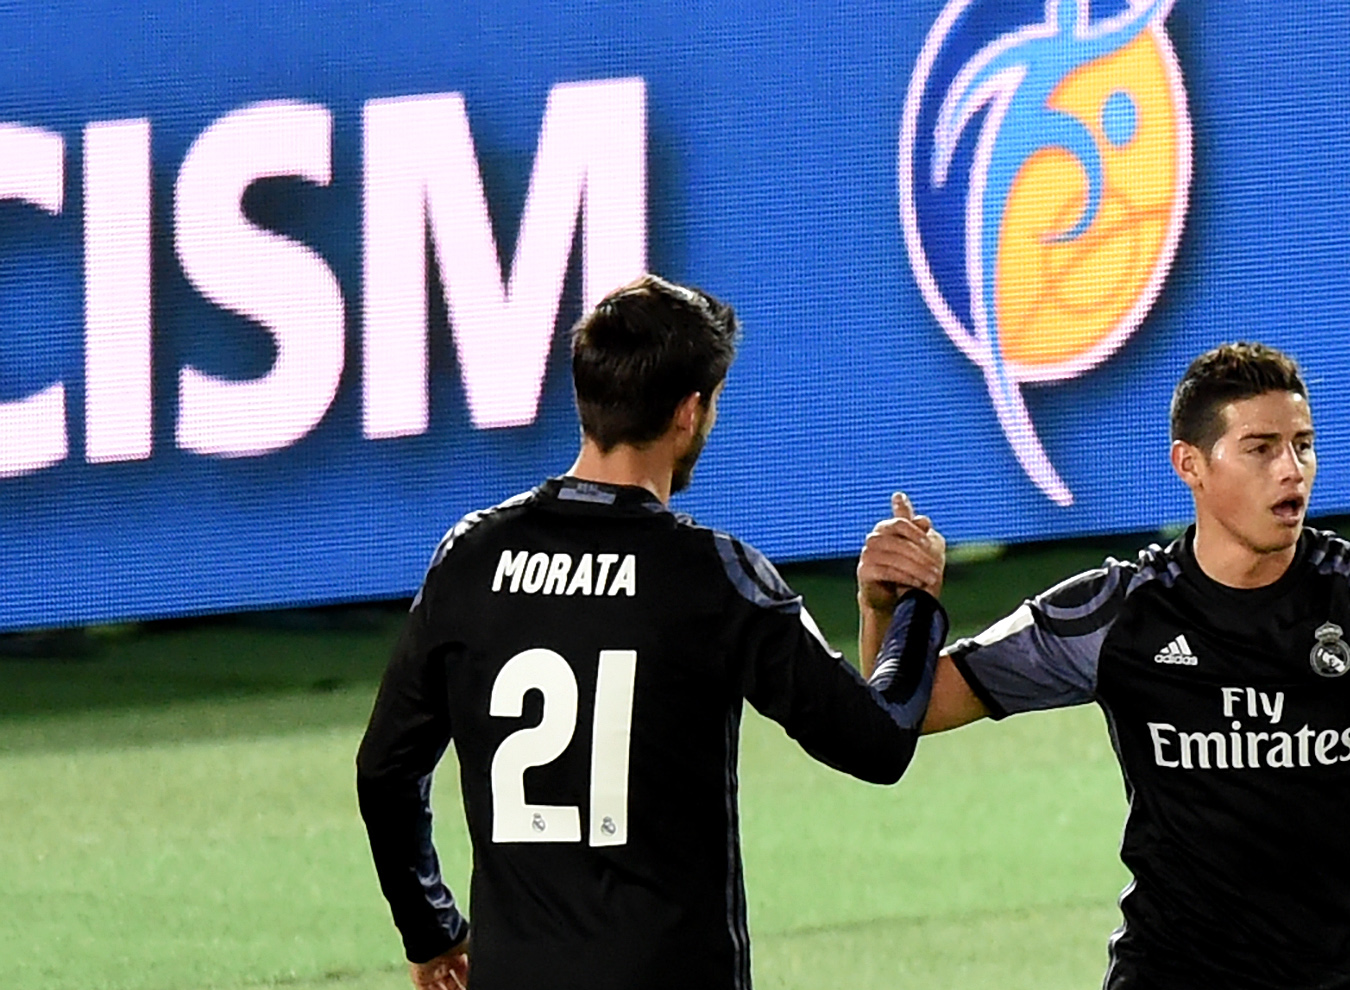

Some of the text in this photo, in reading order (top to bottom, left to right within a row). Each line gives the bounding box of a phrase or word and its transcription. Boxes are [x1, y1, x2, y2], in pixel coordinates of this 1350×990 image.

[491, 550, 636, 597] MORATA
[1220, 686, 1285, 724] Fly
[489, 648, 638, 848] 21
